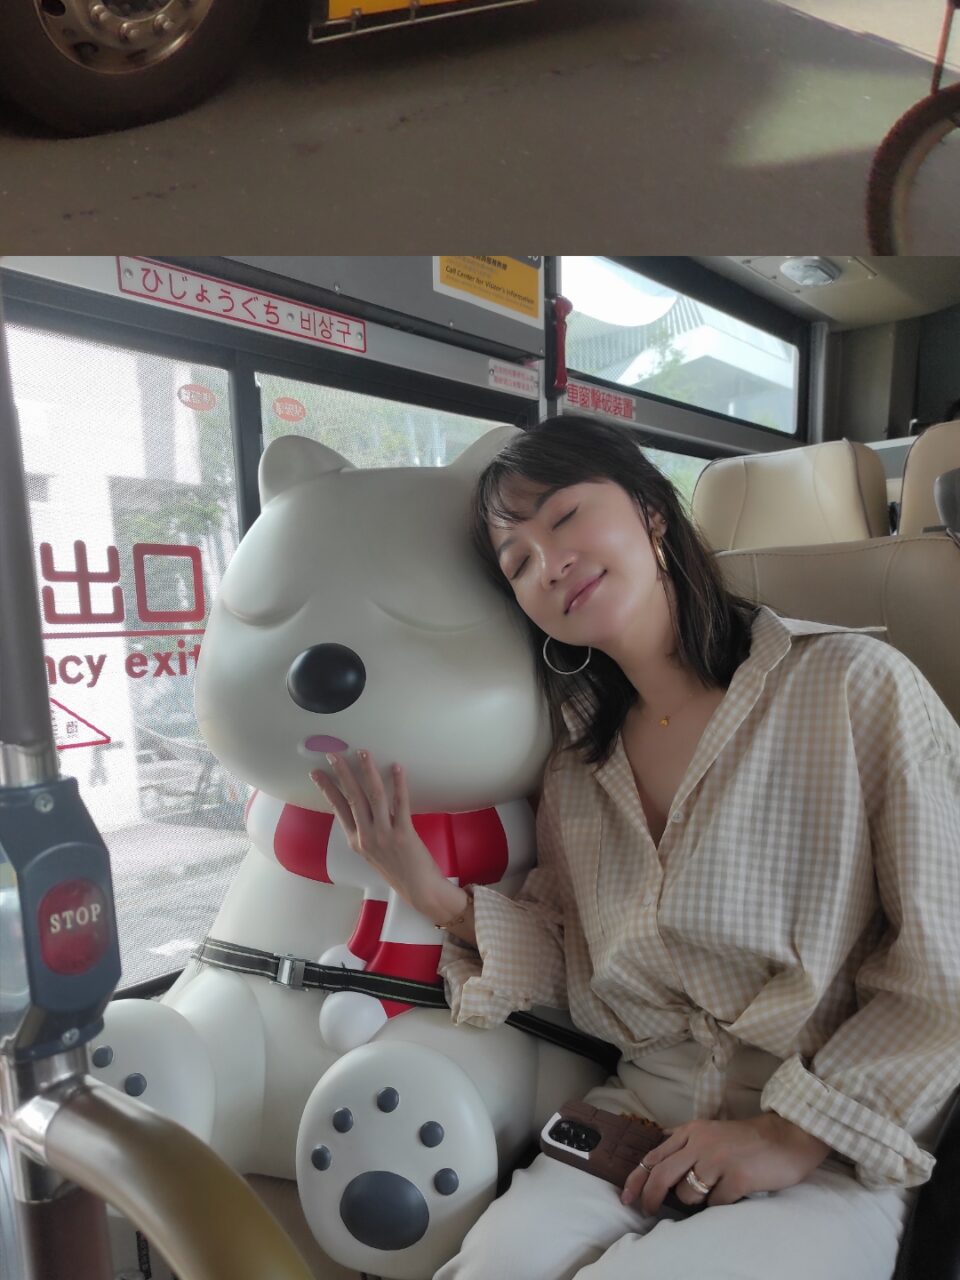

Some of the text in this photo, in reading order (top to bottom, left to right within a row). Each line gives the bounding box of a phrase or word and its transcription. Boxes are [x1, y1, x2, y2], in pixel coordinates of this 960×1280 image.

[300, 310, 352, 344] 비상구
[567, 382, 633, 419] 車窗擊破裝置
[40, 540, 205, 624] 出口
[50, 903, 102, 934] STOP
